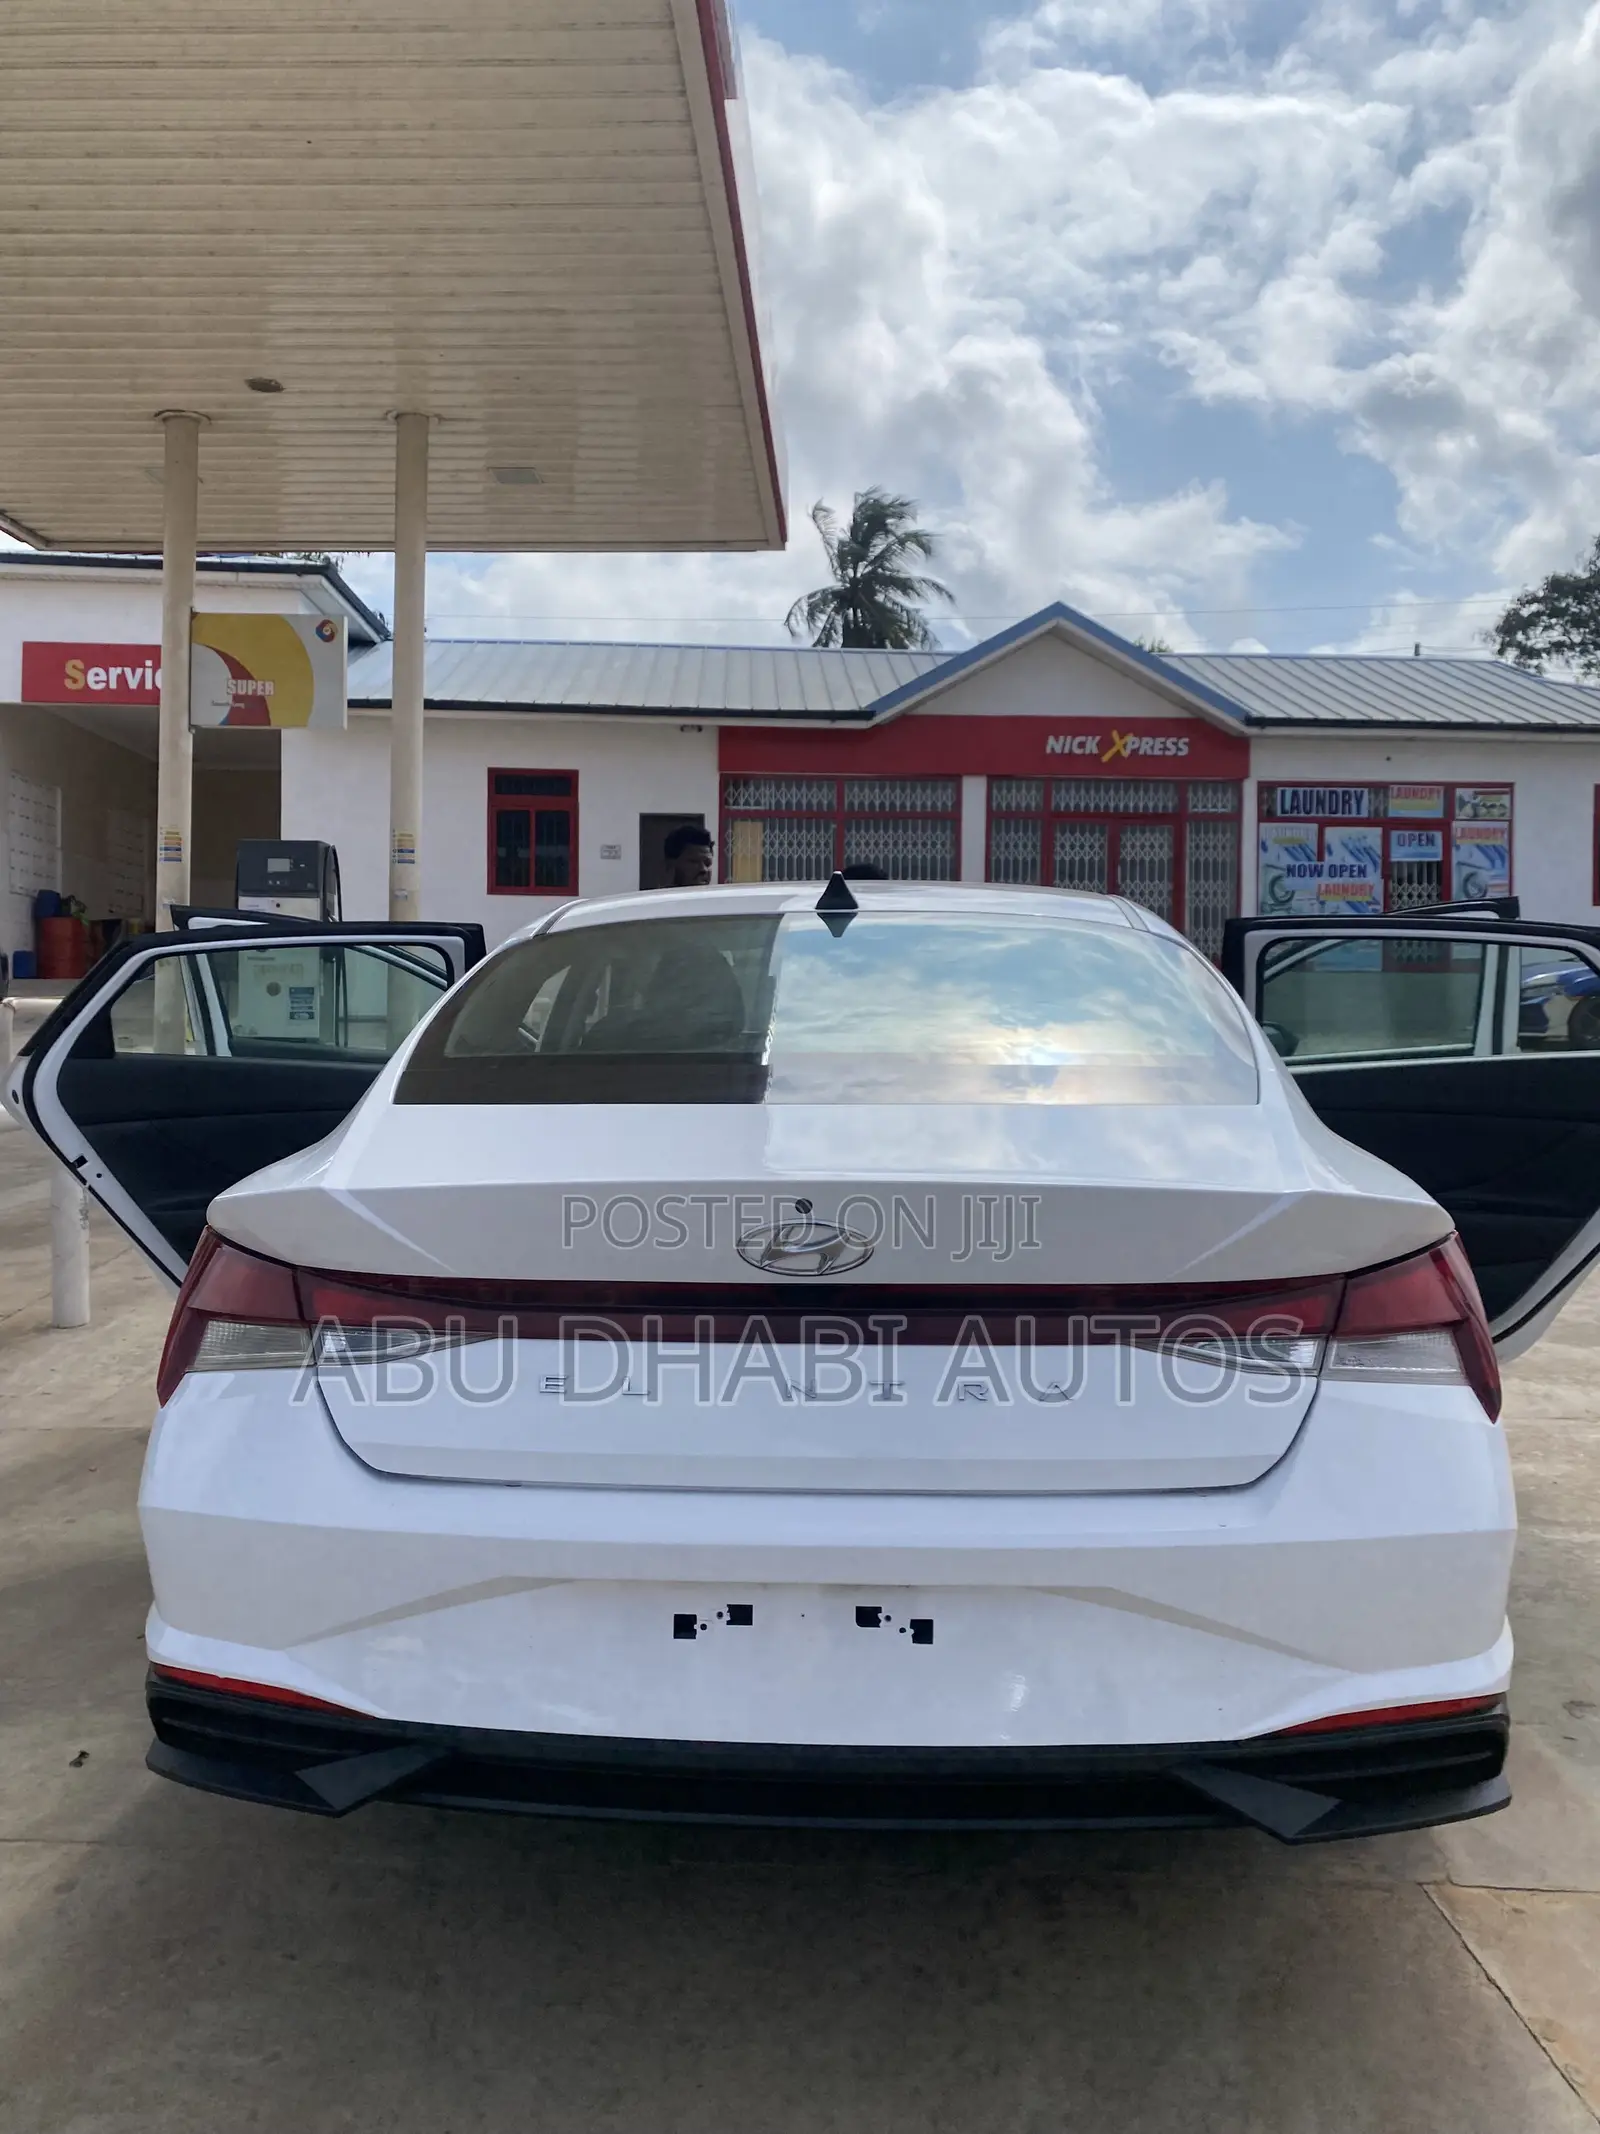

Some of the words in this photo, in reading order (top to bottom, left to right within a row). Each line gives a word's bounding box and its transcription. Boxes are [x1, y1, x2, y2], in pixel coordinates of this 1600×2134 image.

[226, 679, 275, 696] SUPER
[1045, 735, 1101, 754] NICK
[1101, 729, 1190, 763] XPRESS
[1280, 789, 1365, 815] LAUNDRY
[1397, 832, 1436, 848] OPEN
[1286, 863, 1324, 878] NOW
[1328, 863, 1368, 878] OPEN
